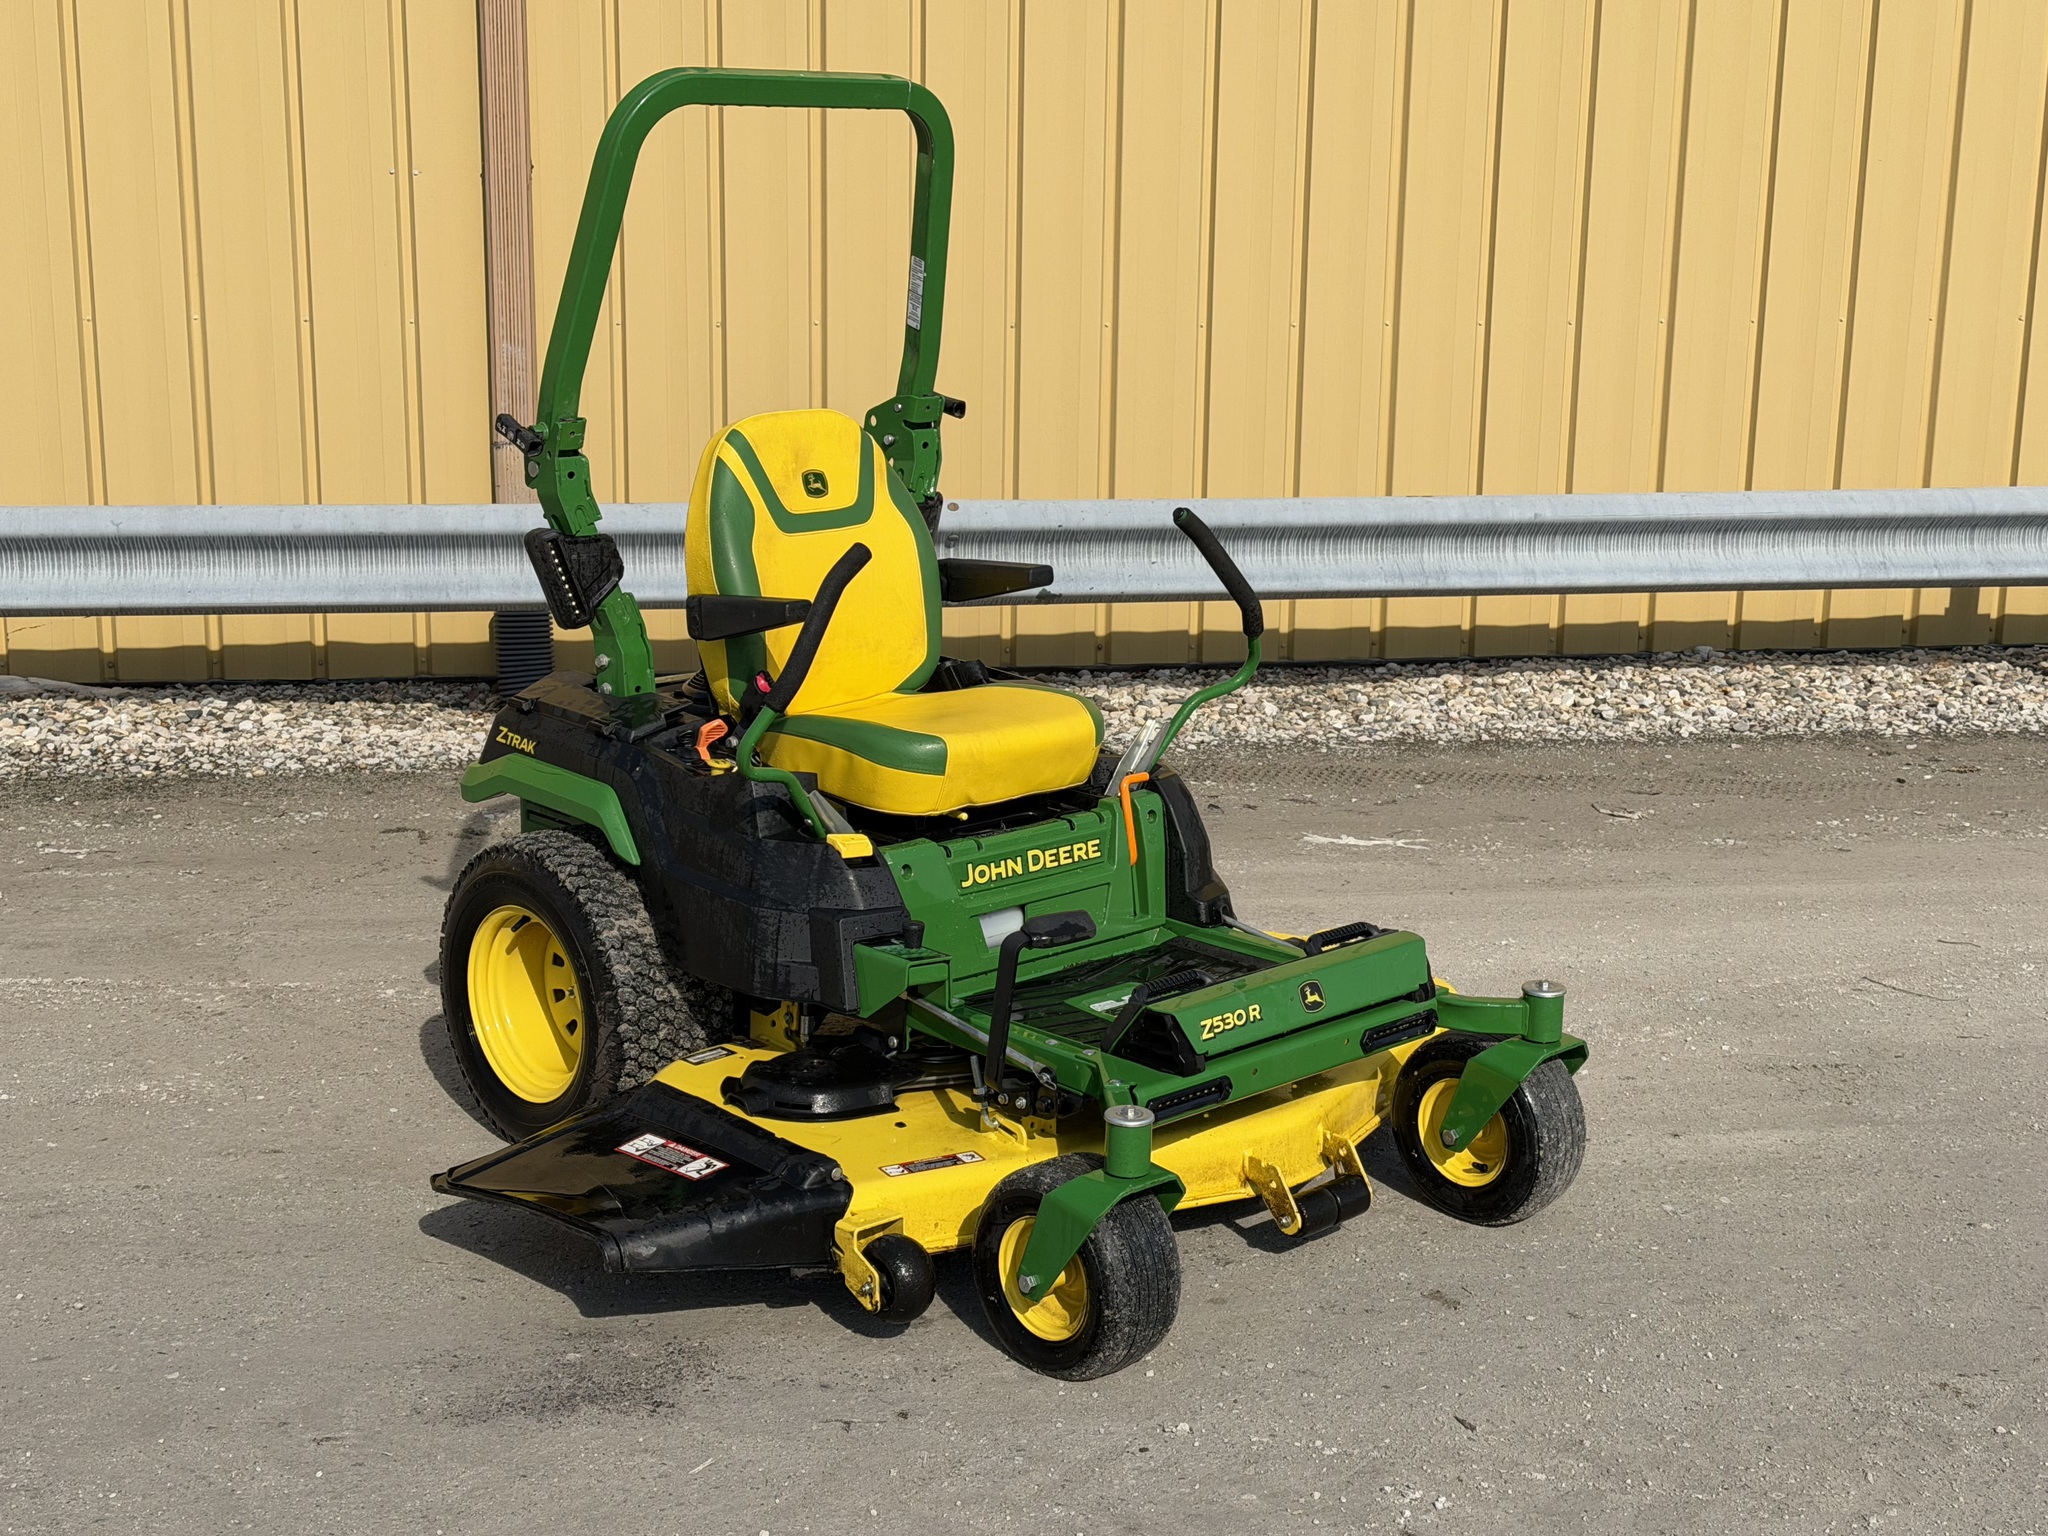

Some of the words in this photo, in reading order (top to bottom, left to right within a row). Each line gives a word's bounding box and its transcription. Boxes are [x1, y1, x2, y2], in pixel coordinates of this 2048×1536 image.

[496, 725, 537, 755] ZTRAK
[961, 856, 1023, 888] JOHN
[1026, 839, 1101, 872] DEERE
[1200, 1009, 1247, 1040] Z530
[1248, 1004, 1262, 1022] R
